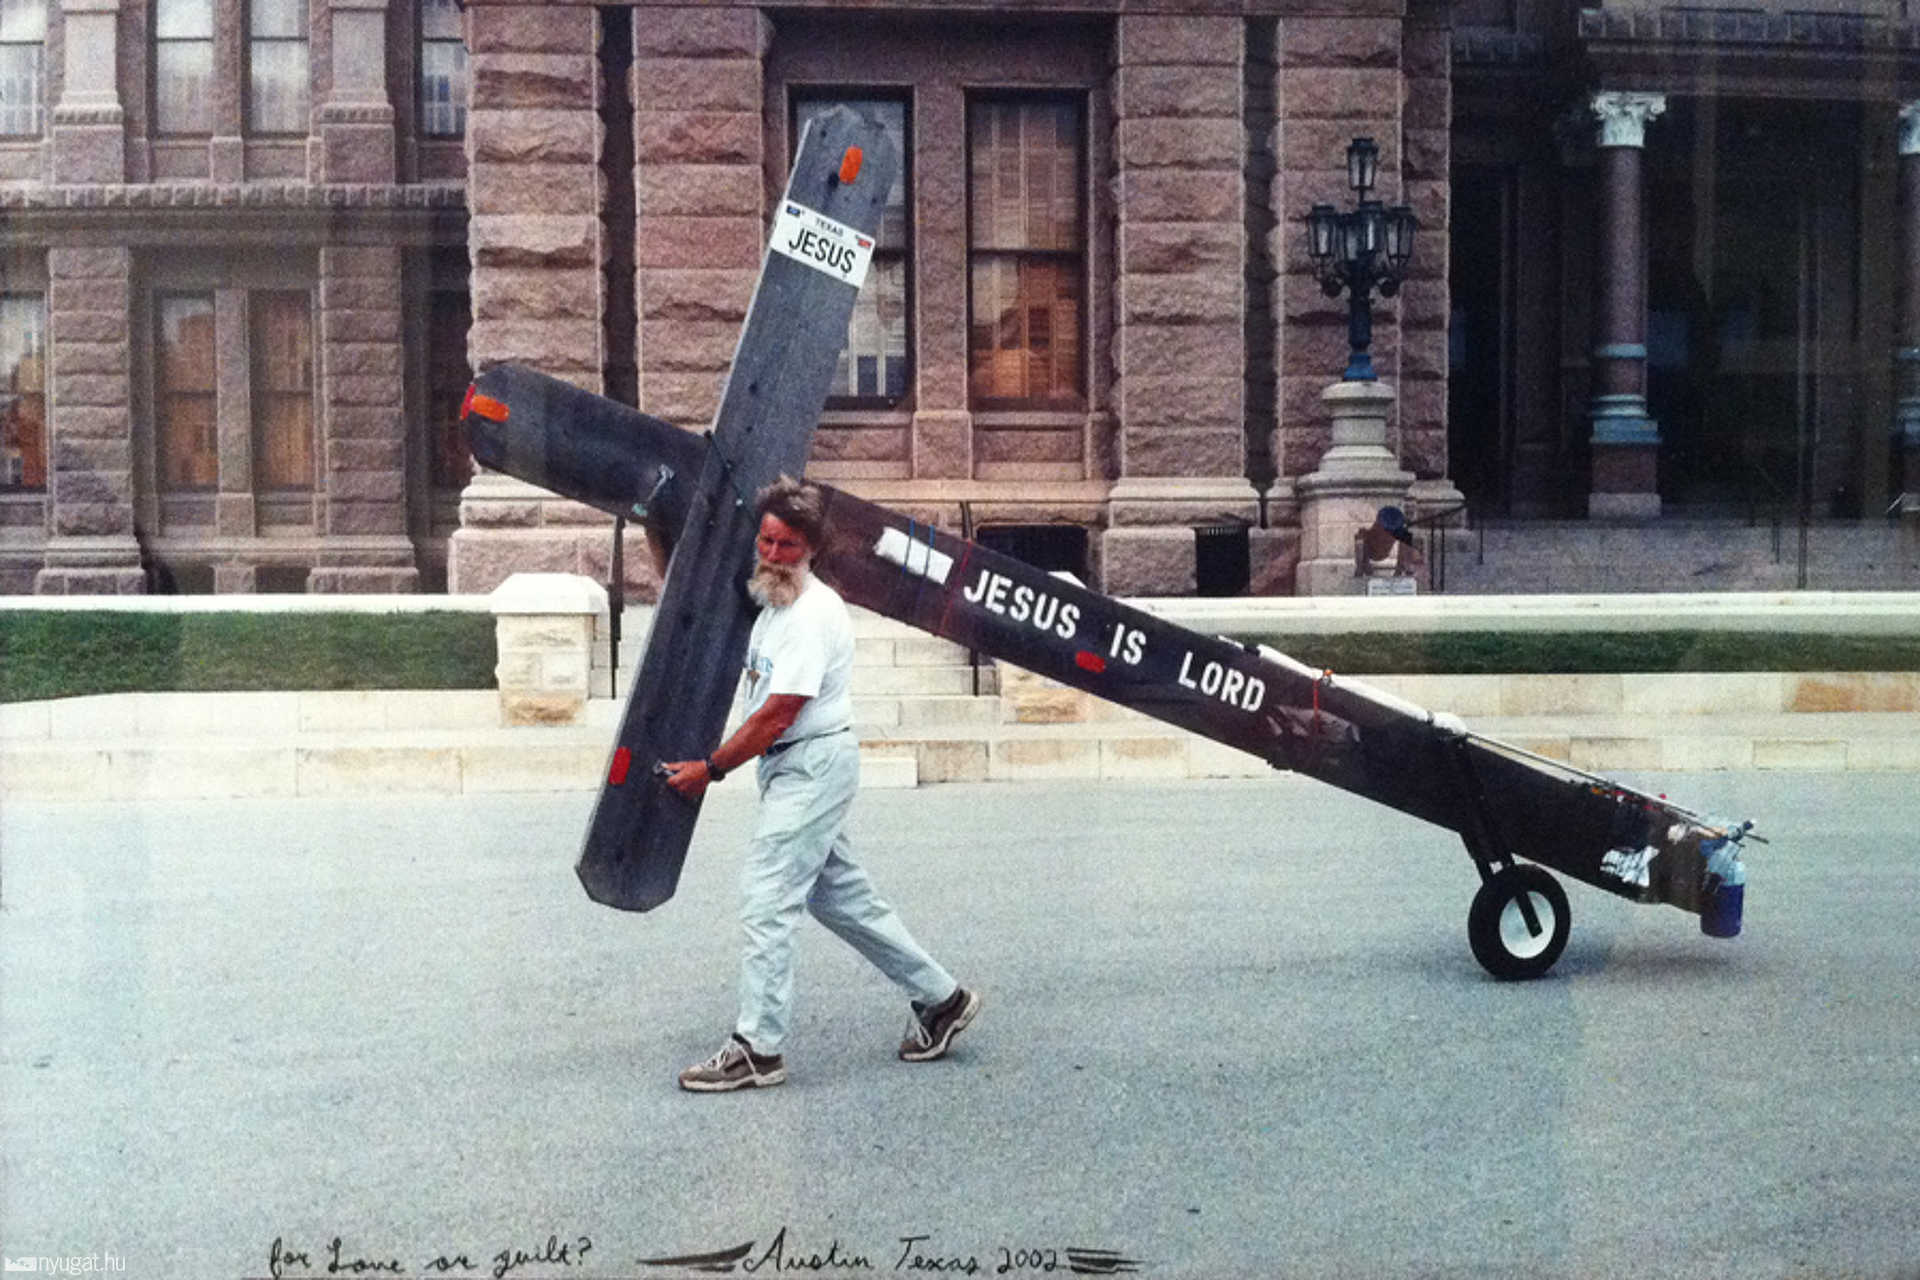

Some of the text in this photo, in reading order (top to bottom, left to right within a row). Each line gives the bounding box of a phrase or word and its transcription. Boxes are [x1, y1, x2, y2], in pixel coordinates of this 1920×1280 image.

[788, 227, 857, 274] JESUS
[815, 217, 844, 237] TEXAS
[963, 570, 1266, 712] JESUS IS LORD
[270, 1236, 312, 1280] for
[742, 1226, 1058, 1273] Austin Texas 2002
